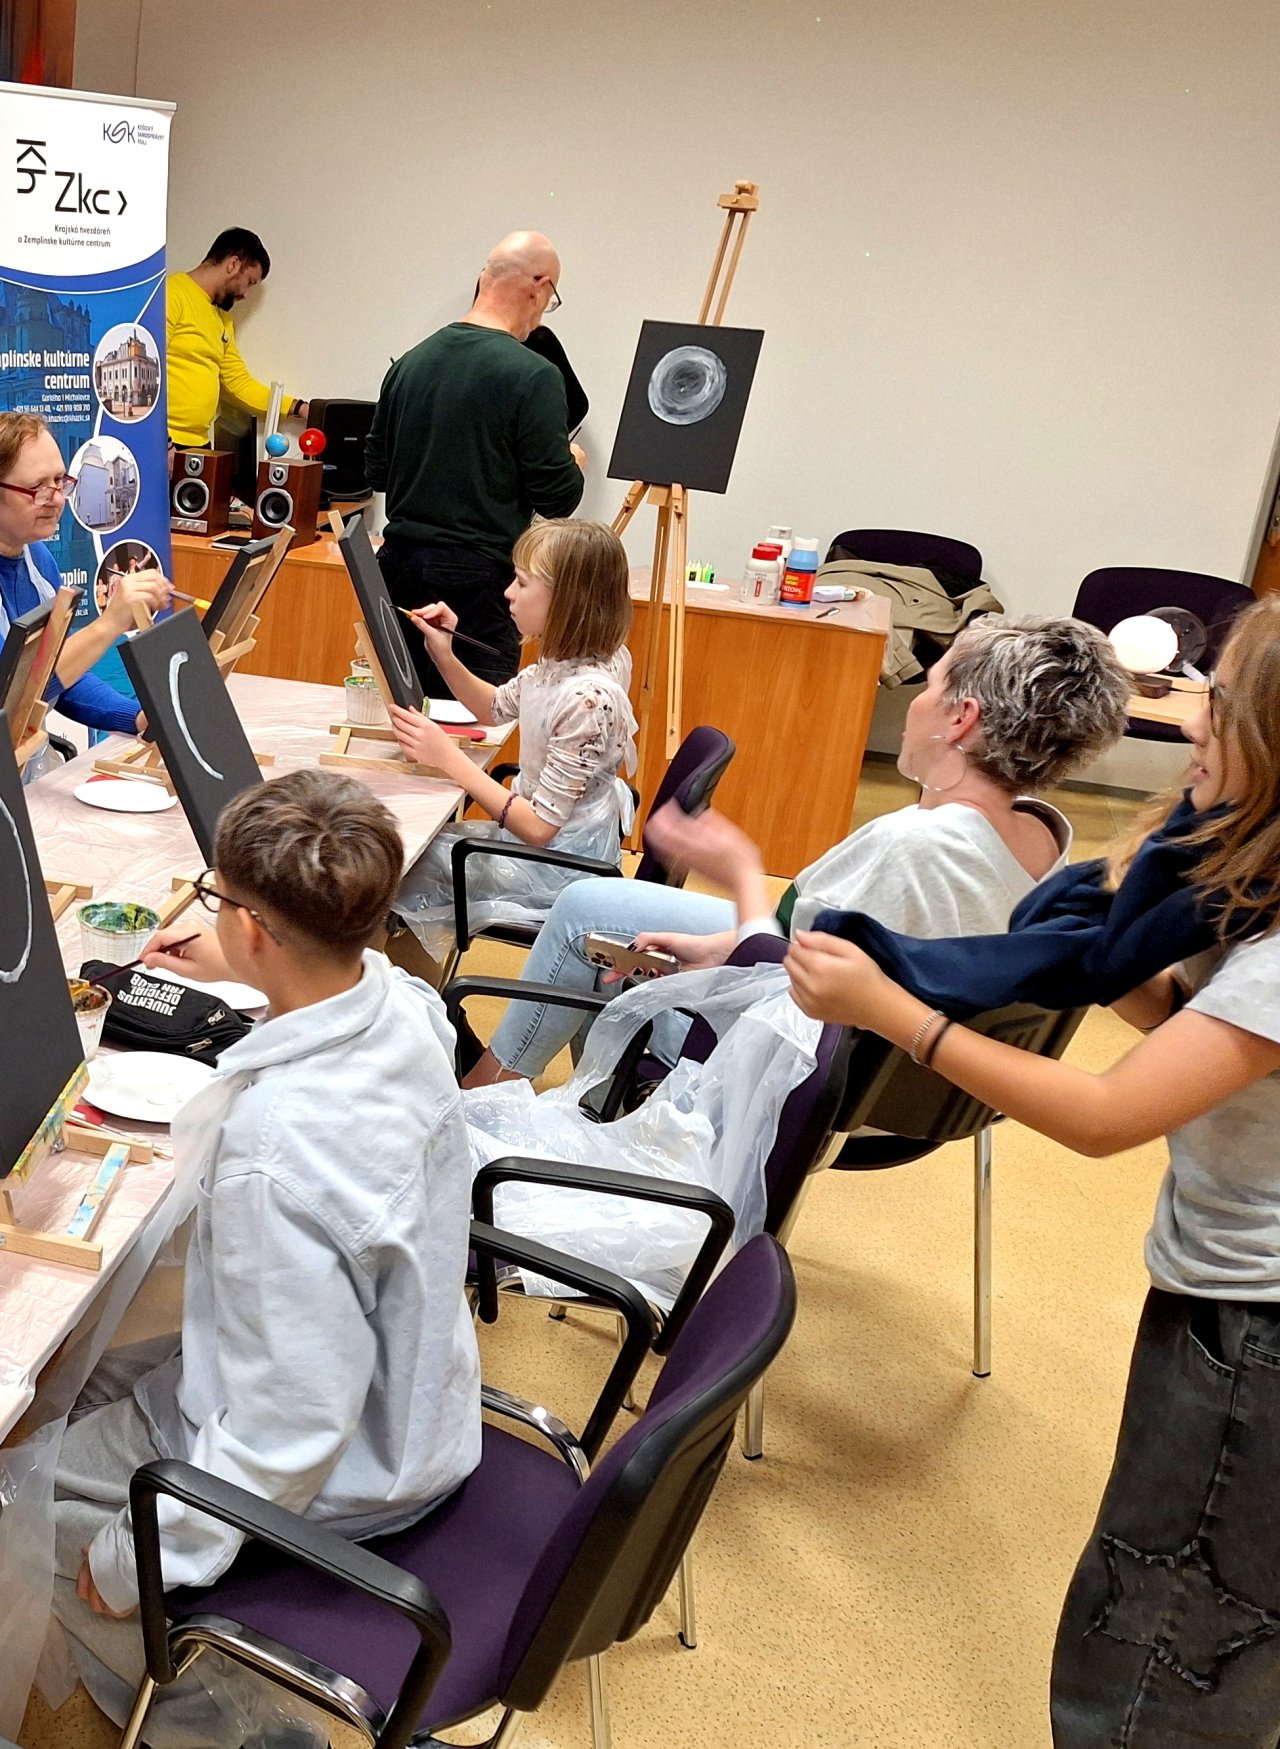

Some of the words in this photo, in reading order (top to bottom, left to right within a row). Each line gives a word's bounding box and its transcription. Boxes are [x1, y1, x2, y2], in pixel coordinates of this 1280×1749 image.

[54, 224, 78, 235] Krajská
[85, 238, 111, 248] centrum
[43, 349, 90, 368] kultúrne
[44, 373, 90, 389] centrum
[130, 973, 160, 989] CLUB
[161, 983, 186, 995] FAN
[117, 989, 177, 1016] JUVENTUS
[130, 985, 182, 1006] OFFICIAL
